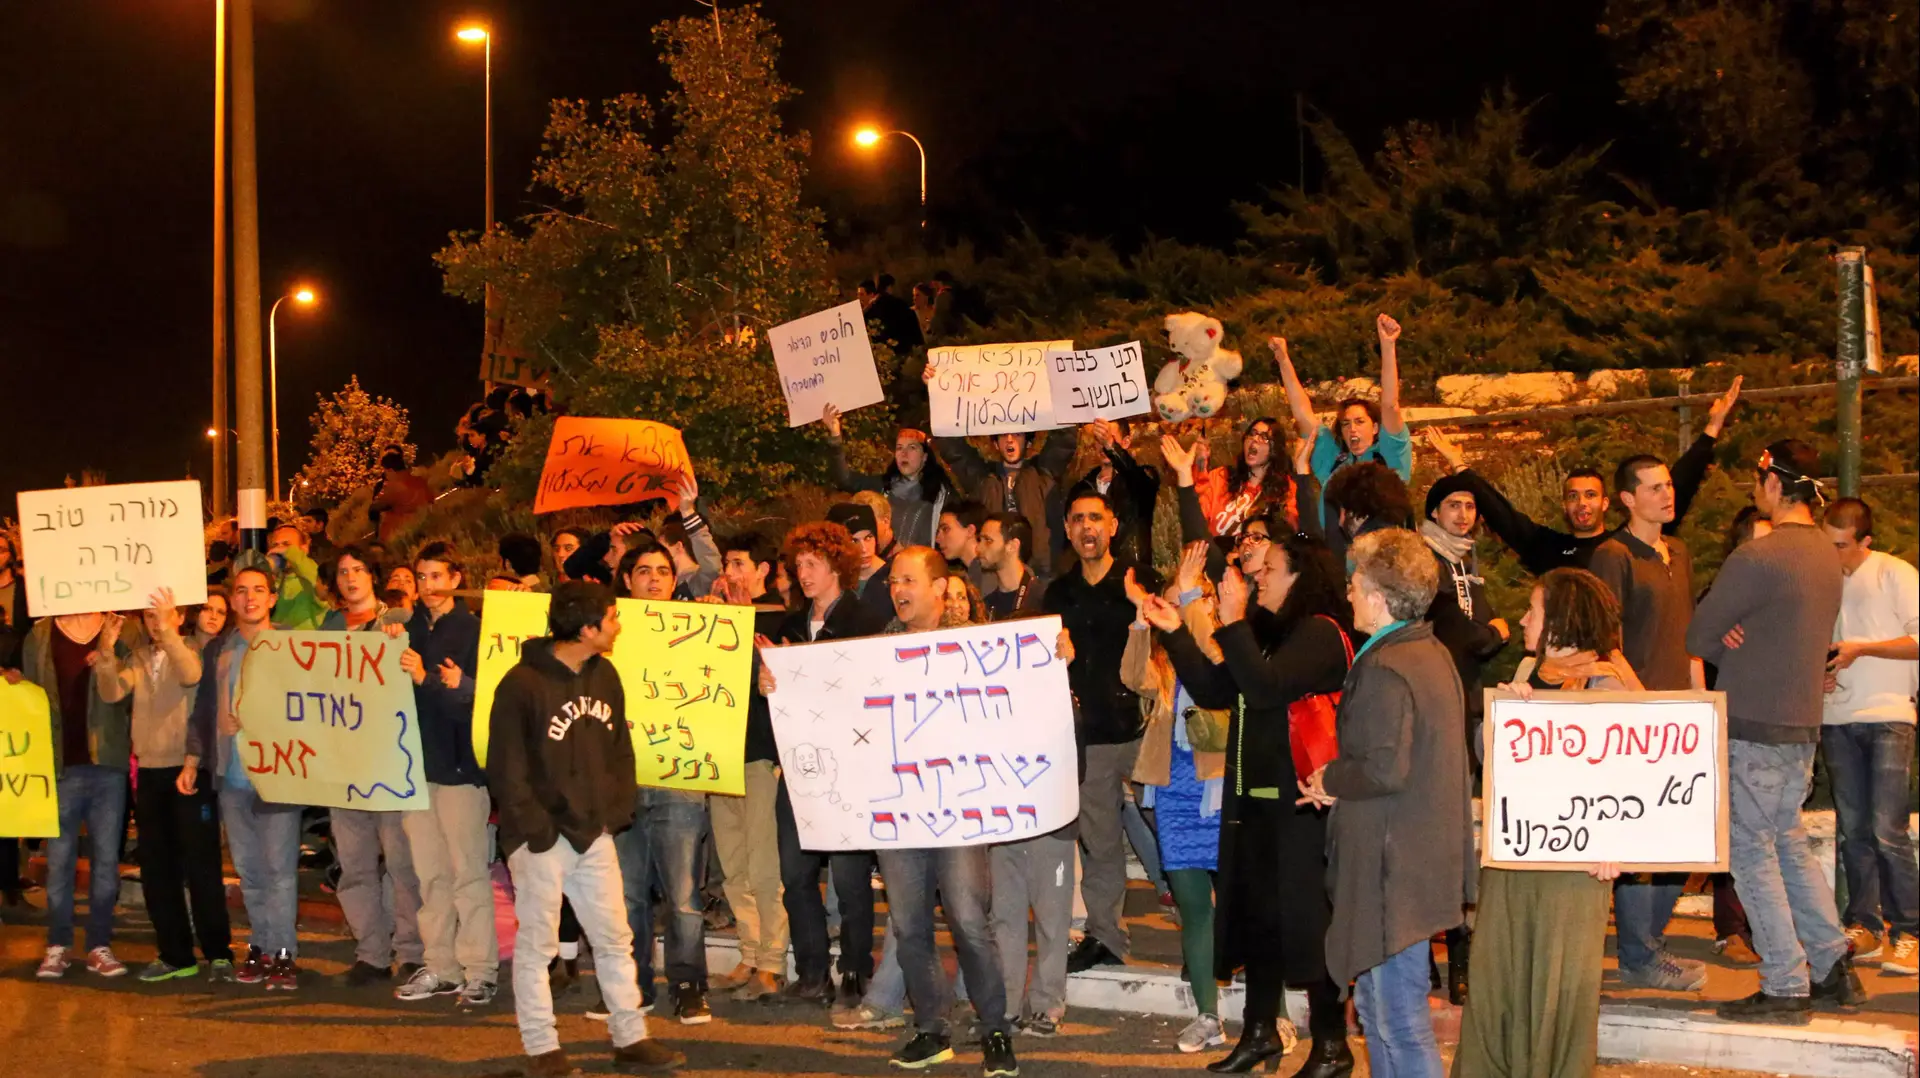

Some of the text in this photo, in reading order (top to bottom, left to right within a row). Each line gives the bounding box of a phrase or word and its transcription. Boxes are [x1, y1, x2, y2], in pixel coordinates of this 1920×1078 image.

[934, 347, 964, 368] את
[1110, 346, 1137, 369] תנו
[938, 370, 1036, 393] רשת אורט
[1072, 372, 1139, 409] לחשוב
[955, 393, 1037, 436] מטבעון!
[556, 434, 604, 456] את
[39, 571, 133, 610] לחיים!
[894, 632, 1052, 676] משרד
[286, 691, 363, 731] לאדם
[578, 695, 614, 731] NAV
[864, 682, 1013, 764] החינוך
[247, 739, 317, 779] זאב
[1503, 718, 1699, 765] סתימת פיות?
[0, 772, 50, 799] רש
[869, 753, 1051, 809] שתיקת
[1558, 772, 1707, 821] לא בבית
[869, 804, 1038, 841] הכבשים
[1501, 796, 1590, 857] ספרנו!
